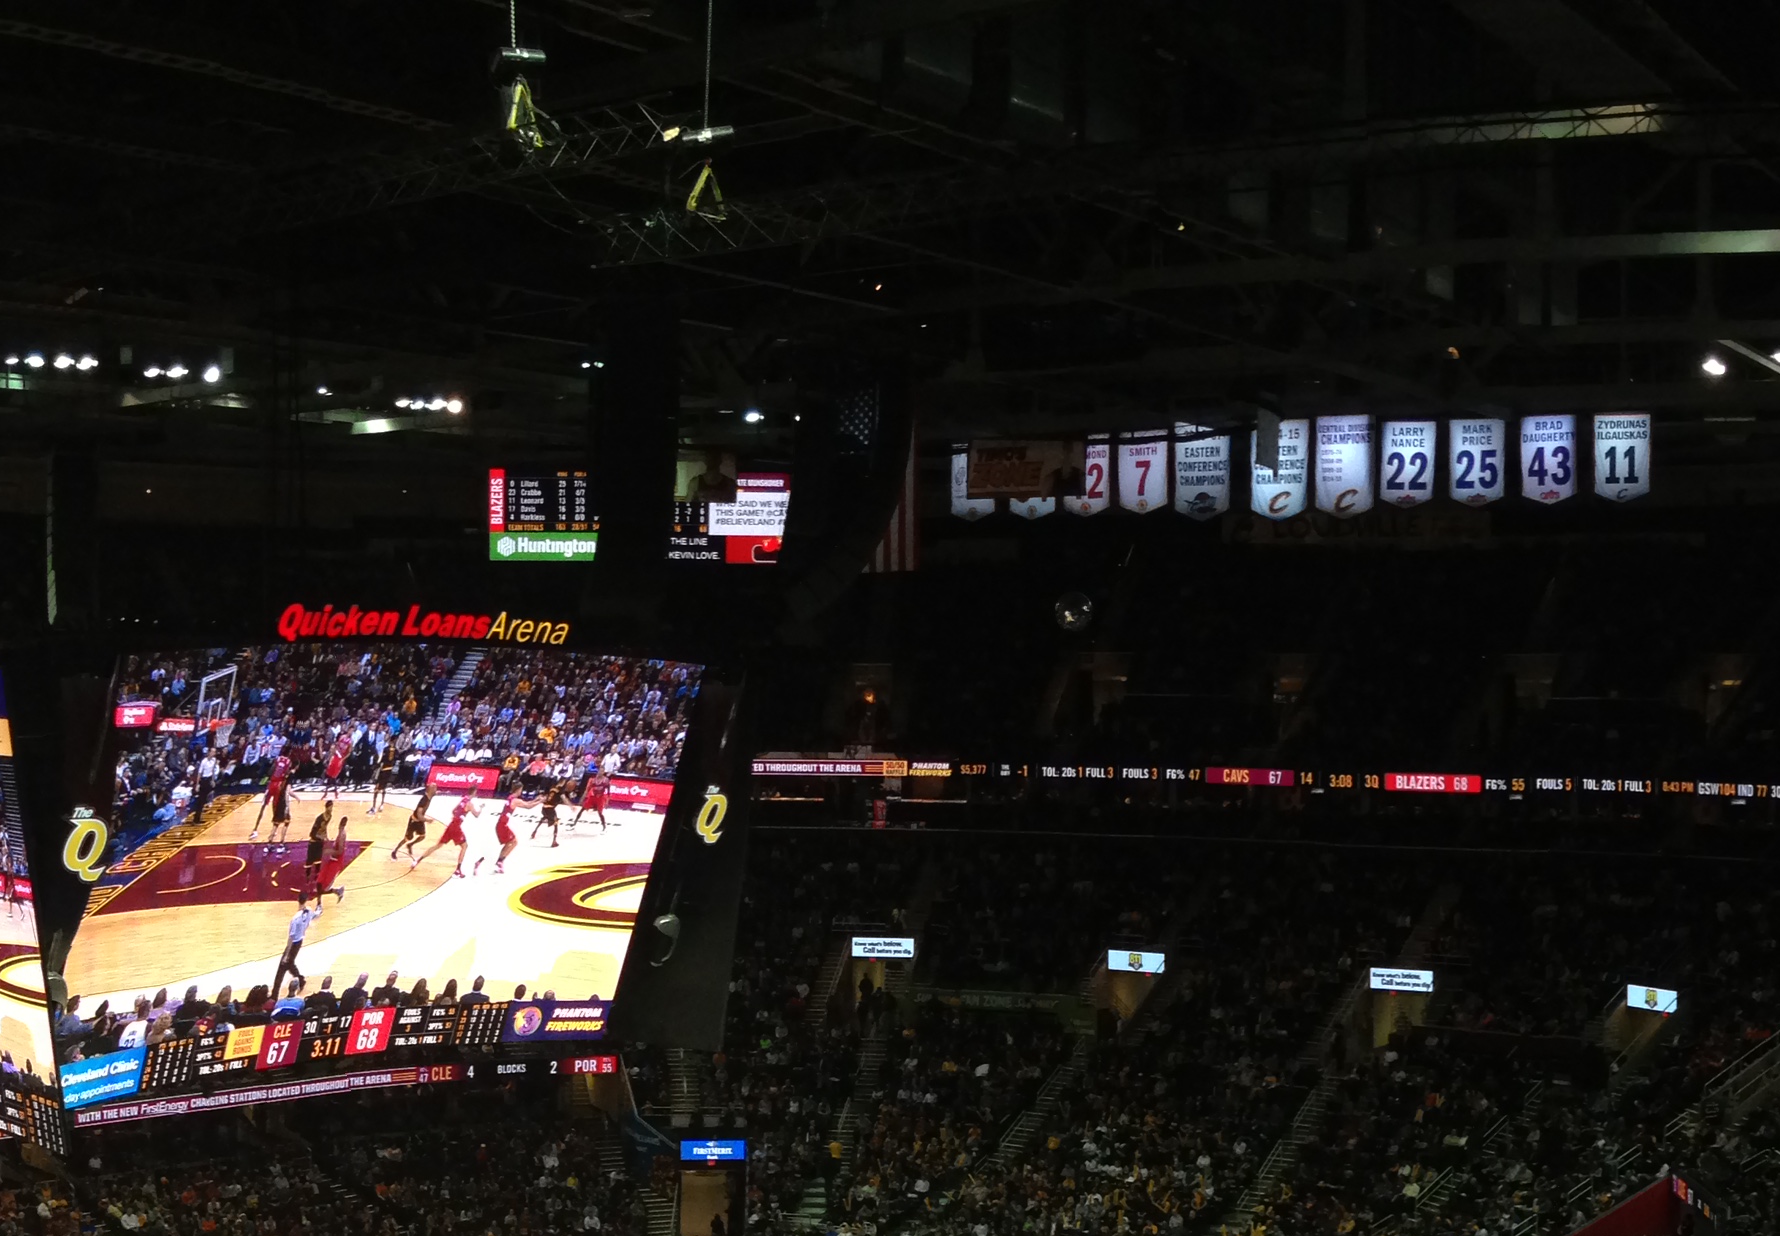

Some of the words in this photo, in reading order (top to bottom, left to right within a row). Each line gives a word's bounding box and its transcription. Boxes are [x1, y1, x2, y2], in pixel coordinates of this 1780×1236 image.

[1461, 424, 1493, 435] MARK
[1534, 420, 1564, 431] BRAD
[1597, 419, 1647, 430] ZYDRUNAS
[1391, 426, 1425, 437] LARRY
[1522, 431, 1576, 443] DAUGHERTY
[1597, 430, 1648, 441] ILGAUSKAS
[1390, 437, 1426, 448] NANCE
[1461, 435, 1493, 446] PRICE
[1129, 446, 1157, 458] SMITH
[1184, 446, 1221, 459] EASTERN
[1178, 460, 1228, 472] CONFERENCE
[1386, 451, 1429, 491] 22
[1455, 449, 1499, 490] 25
[1527, 445, 1572, 487] 43
[1604, 445, 1639, 485] 11
[1135, 460, 1151, 496] 7
[1179, 474, 1225, 487] CHAMPIONS
[490, 477, 504, 525] BLAZERS
[517, 536, 596, 558] Huntington
[670, 537, 685, 546] THE
[686, 537, 708, 546] LINE
[668, 551, 694, 560] KEVIN
[695, 551, 721, 560] LOVE.
[278, 602, 400, 642] Quicken
[401, 604, 491, 640] Loans
[486, 610, 570, 645] Arena
[1223, 769, 1250, 783] CAVS
[1268, 771, 1282, 784] 67
[1329, 774, 1353, 788] 3:08
[1395, 775, 1445, 790] BLAZERS
[1453, 777, 1468, 791] 68
[1536, 778, 1563, 791] FOULS
[1698, 783, 1720, 795] GSW
[72, 807, 94, 818] The
[695, 793, 728, 844] Q
[62, 817, 109, 882] Q
[361, 1011, 383, 1025] POR
[552, 1006, 602, 1018] PHANTOM
[340, 1016, 351, 1028] 17
[545, 1020, 604, 1031] FIREWORKS
[273, 1023, 293, 1038] CLE
[356, 1028, 379, 1050] 68
[266, 1040, 290, 1064] 67
[311, 1037, 341, 1058] 3:11
[60, 1062, 110, 1088] Cleveland
[110, 1056, 140, 1074] Clinic
[431, 1065, 453, 1081] CLE
[467, 1065, 475, 1079] 4
[497, 1063, 527, 1075] BLOCKS
[550, 1061, 558, 1075] 2
[574, 1059, 597, 1073] POR
